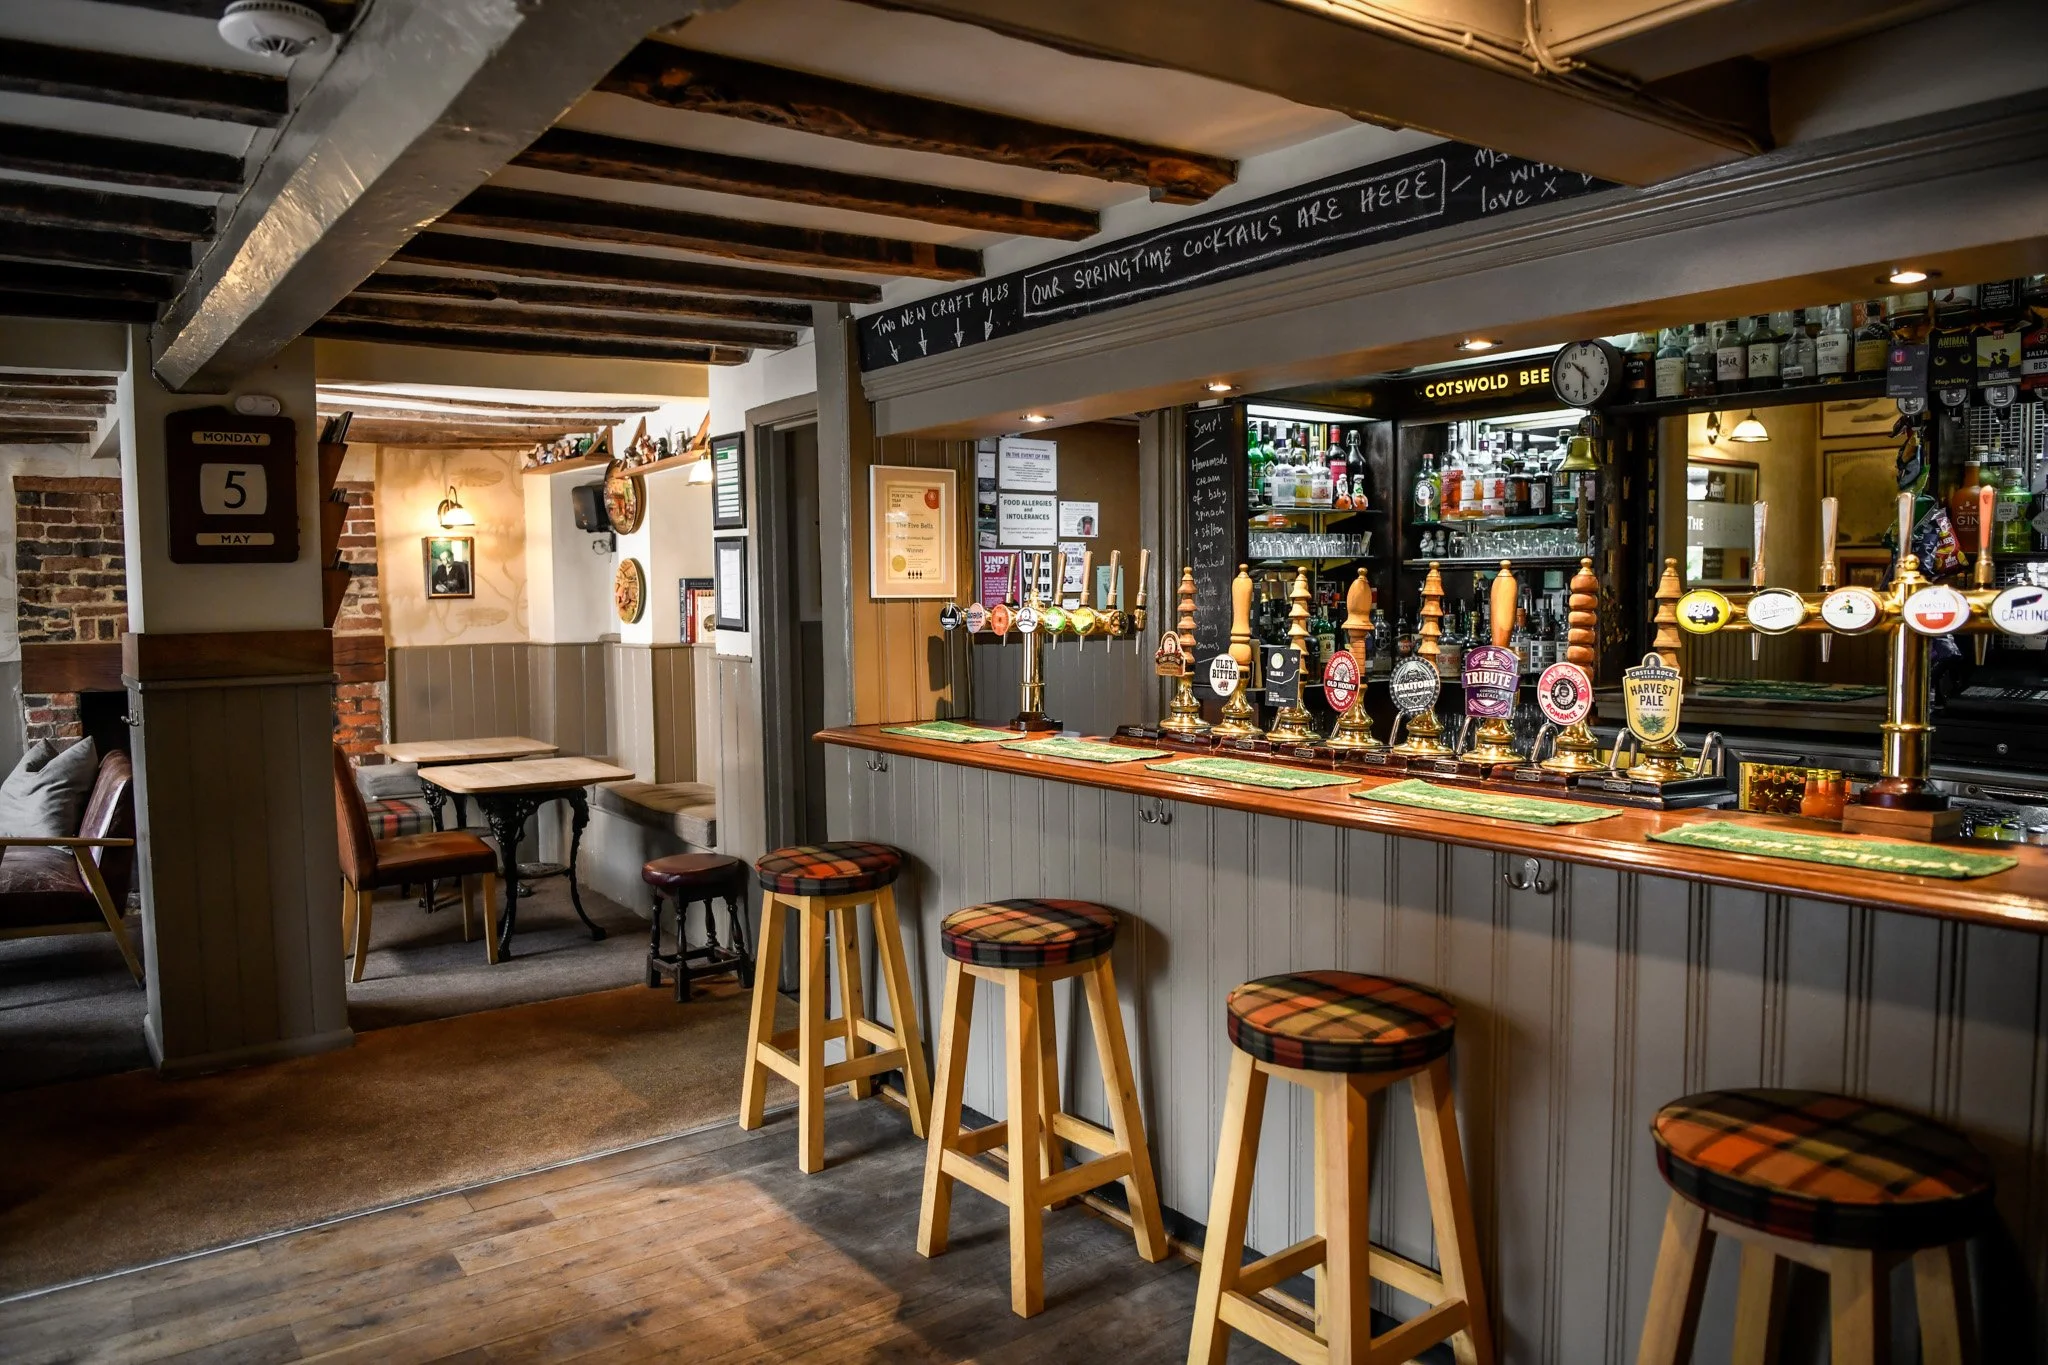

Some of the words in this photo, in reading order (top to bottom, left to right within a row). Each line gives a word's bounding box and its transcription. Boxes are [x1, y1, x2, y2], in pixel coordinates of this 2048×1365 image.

[1482, 186, 1531, 213] love
[1032, 275, 1064, 305] OUR
[1074, 246, 1171, 289] SPRINGTIME
[1183, 215, 1282, 257] COCKTAILS
[1297, 198, 1343, 229] ARE
[1360, 171, 1435, 213] HERE
[901, 306, 926, 327] NEW
[931, 293, 974, 317] CRAFT
[982, 283, 1009, 307] ALES
[1937, 335, 1969, 347] ANIMAL
[1425, 374, 1509, 398] COTSWOLD
[1194, 413, 1222, 438] Soup!
[203, 433, 261, 443] MONDAY
[1191, 453, 1228, 472] Homemade
[1195, 475, 1220, 486] cream
[224, 470, 247, 509] 5
[1193, 489, 1203, 505] of
[1208, 488, 1227, 504] baby
[1195, 505, 1225, 521] spinach
[1688, 515, 1704, 530] THE
[221, 535, 251, 544] MAY
[984, 565, 1001, 573] 25?
[1215, 659, 1234, 669] ULEY
[1212, 668, 1237, 680] BITTER
[1465, 672, 1512, 687] TRIBUTE
[1545, 670, 1556, 684] MY
[1558, 666, 1587, 694] MOSAIC
[1631, 669, 1655, 677] CASTLE
[1338, 682, 1356, 691] HOOKY
[1392, 679, 1435, 692] TAKITORU
[1630, 683, 1675, 696] HARVEST
[1640, 695, 1664, 706] PALE
[1545, 703, 1578, 720] ROMANCE
